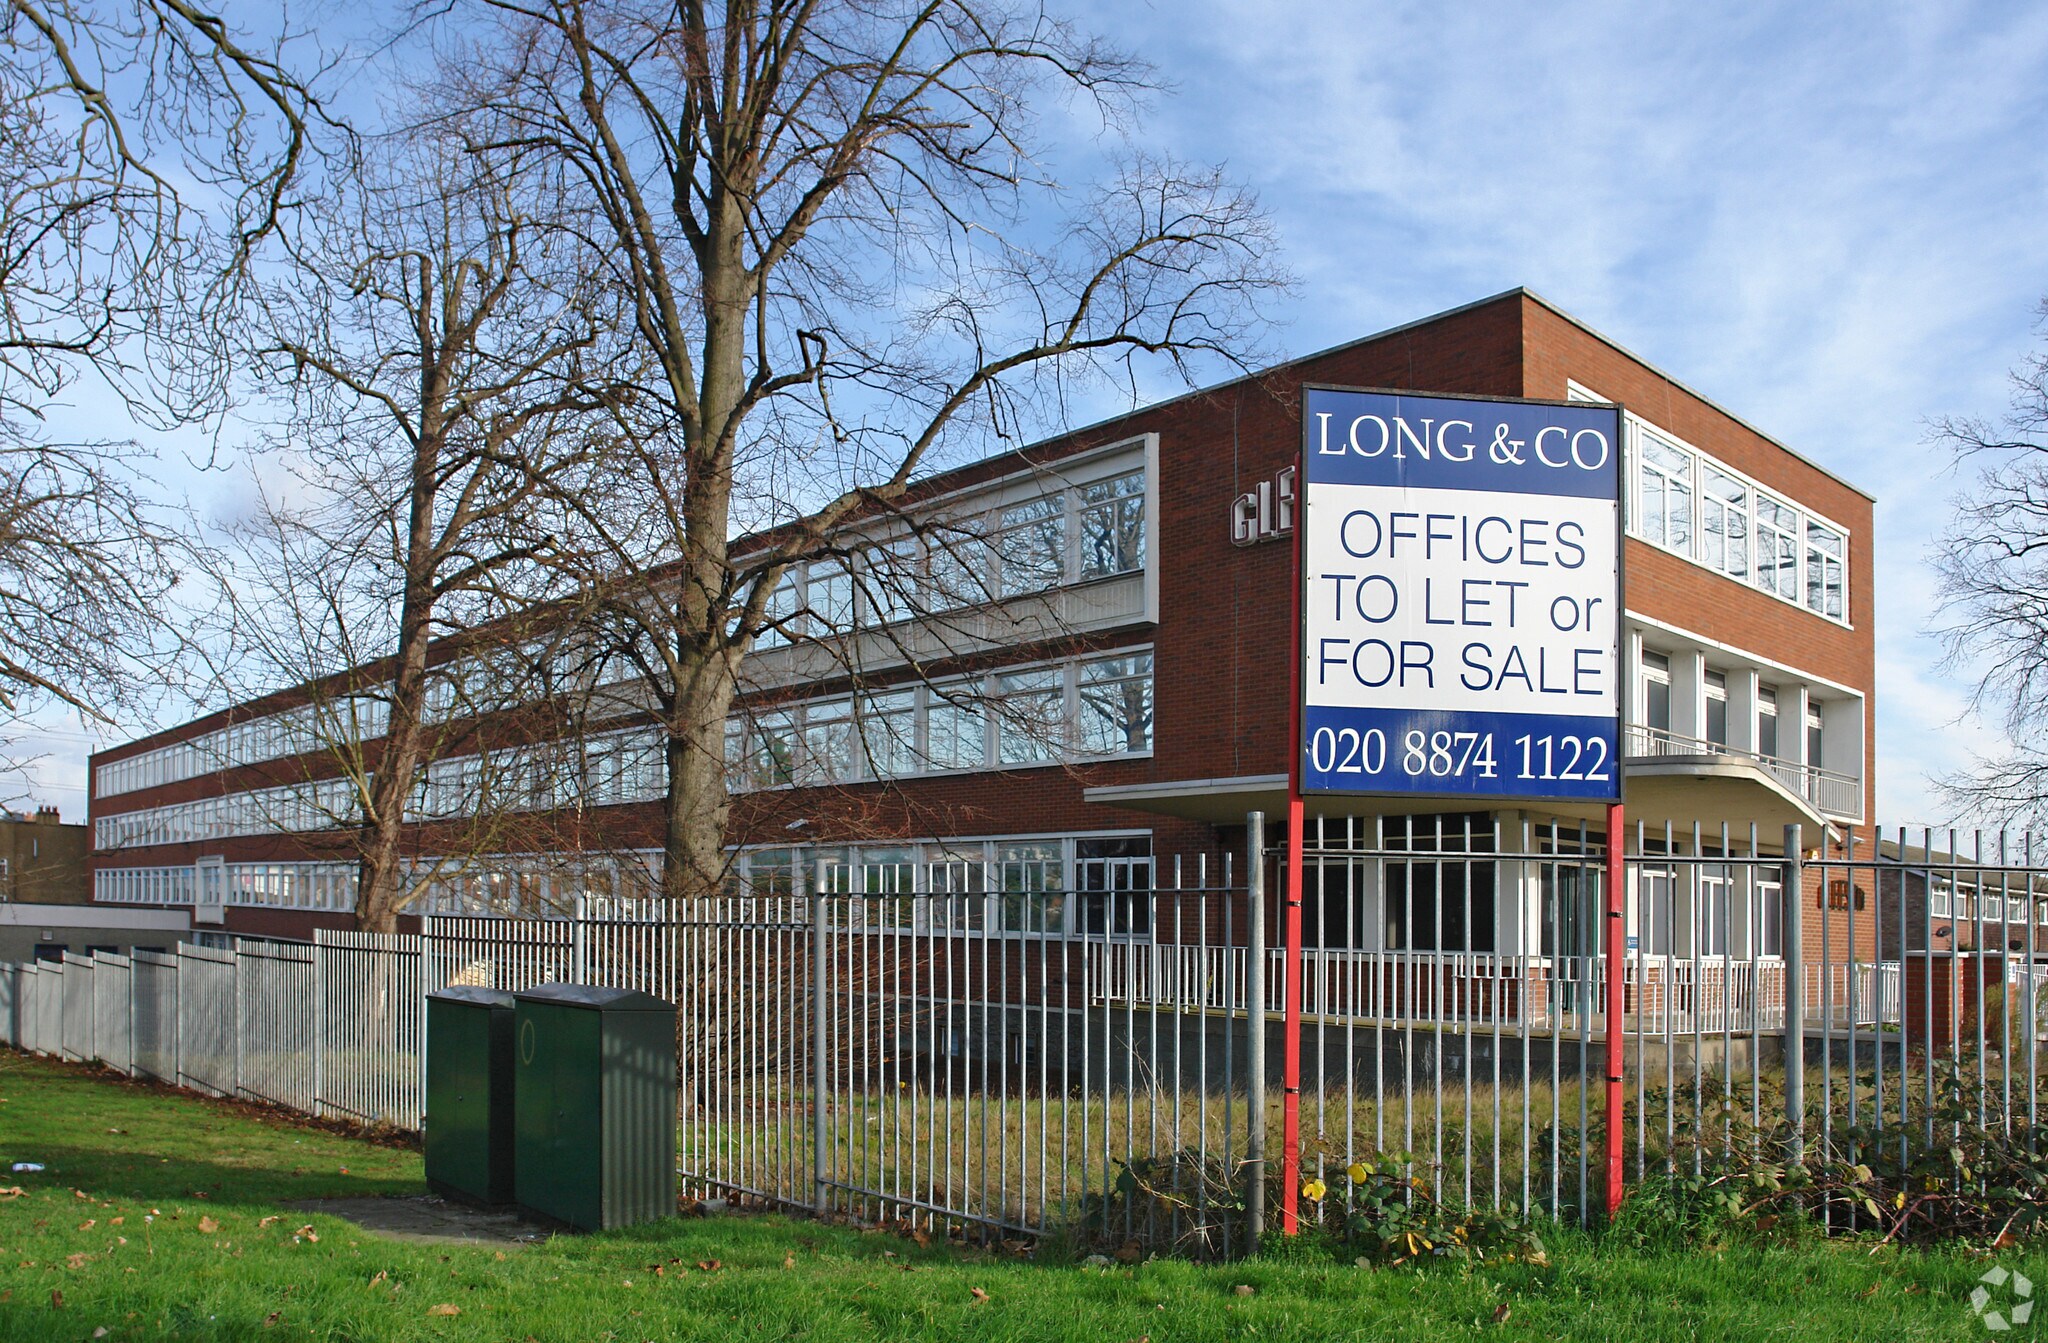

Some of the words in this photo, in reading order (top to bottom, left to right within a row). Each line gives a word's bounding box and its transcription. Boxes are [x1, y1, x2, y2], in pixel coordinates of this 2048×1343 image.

[1316, 413, 1476, 462] LONG
[1489, 423, 1525, 465] &
[1535, 427, 1608, 470] CO
[1341, 510, 1584, 568] OFFICES
[1321, 575, 1398, 623] TO
[1426, 578, 1528, 627] LET
[1551, 596, 1601, 631] or
[1320, 639, 1433, 688] FOR
[1461, 643, 1602, 695] SALE
[1313, 727, 1385, 774] 020
[1404, 730, 1497, 777] 8874
[1516, 735, 1608, 780] 1122
